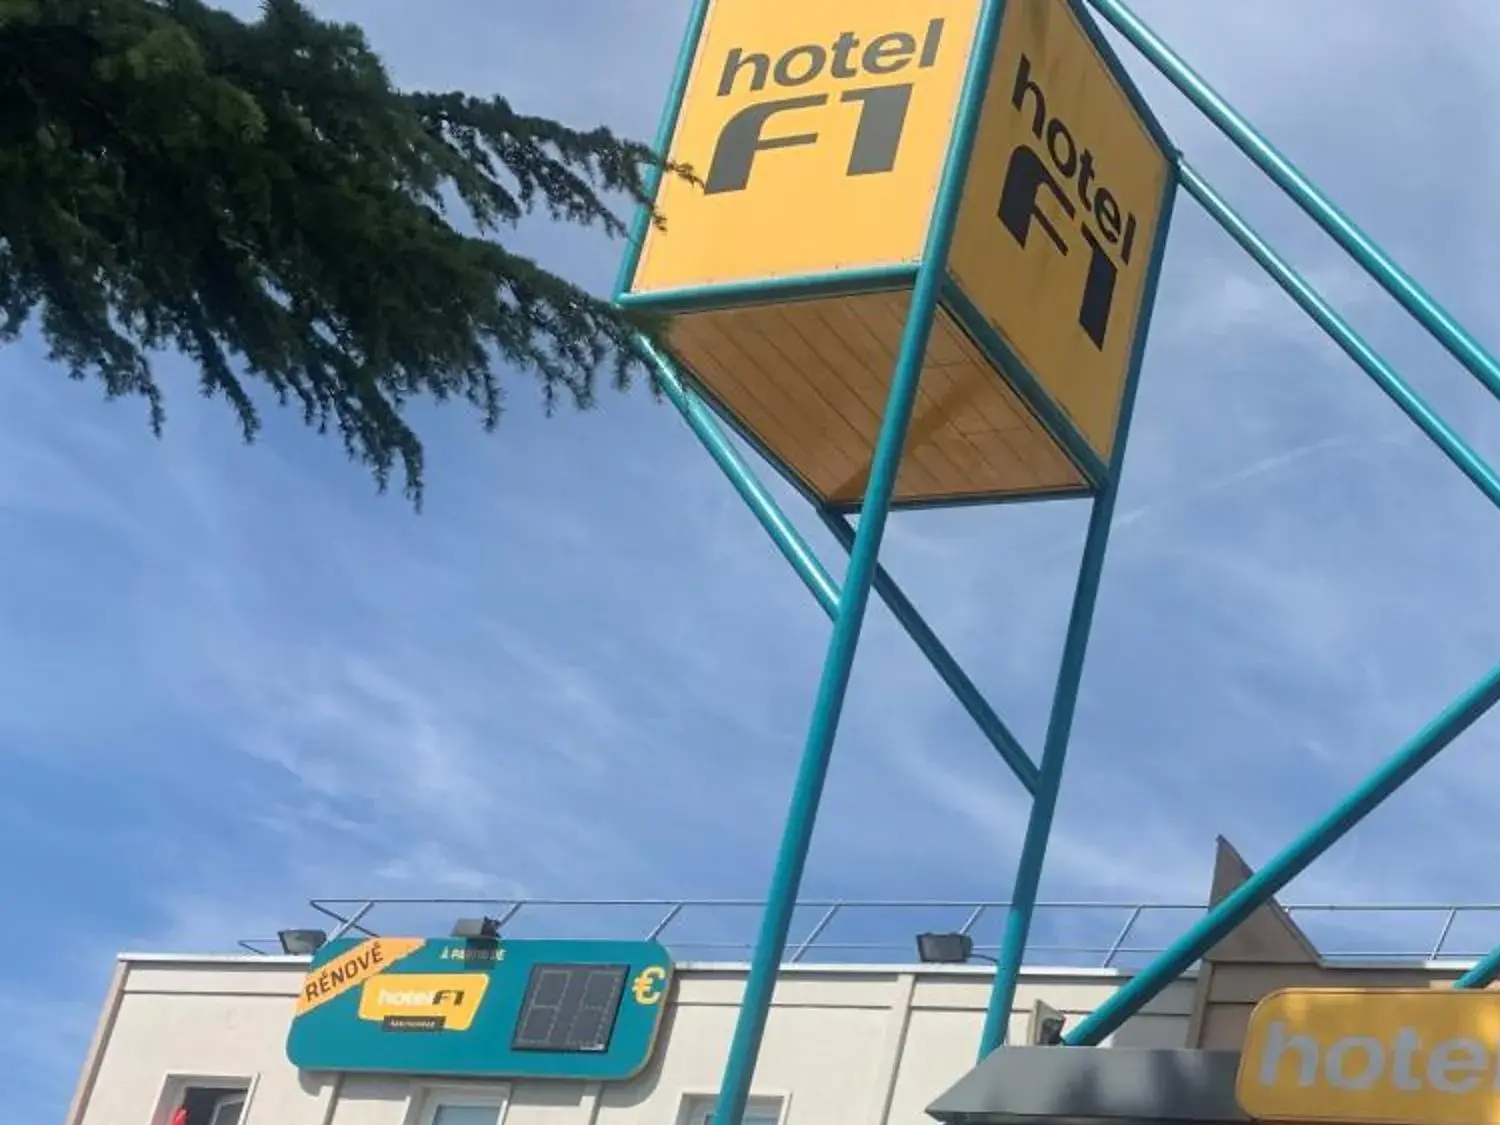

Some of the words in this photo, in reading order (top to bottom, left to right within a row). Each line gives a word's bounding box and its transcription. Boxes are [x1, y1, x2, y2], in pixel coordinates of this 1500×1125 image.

[716, 18, 945, 96] hotel
[703, 83, 914, 195] F1
[1011, 53, 1137, 266] hotel
[997, 144, 1119, 352] F1
[305, 941, 384, 1003] RÉNOVÉ
